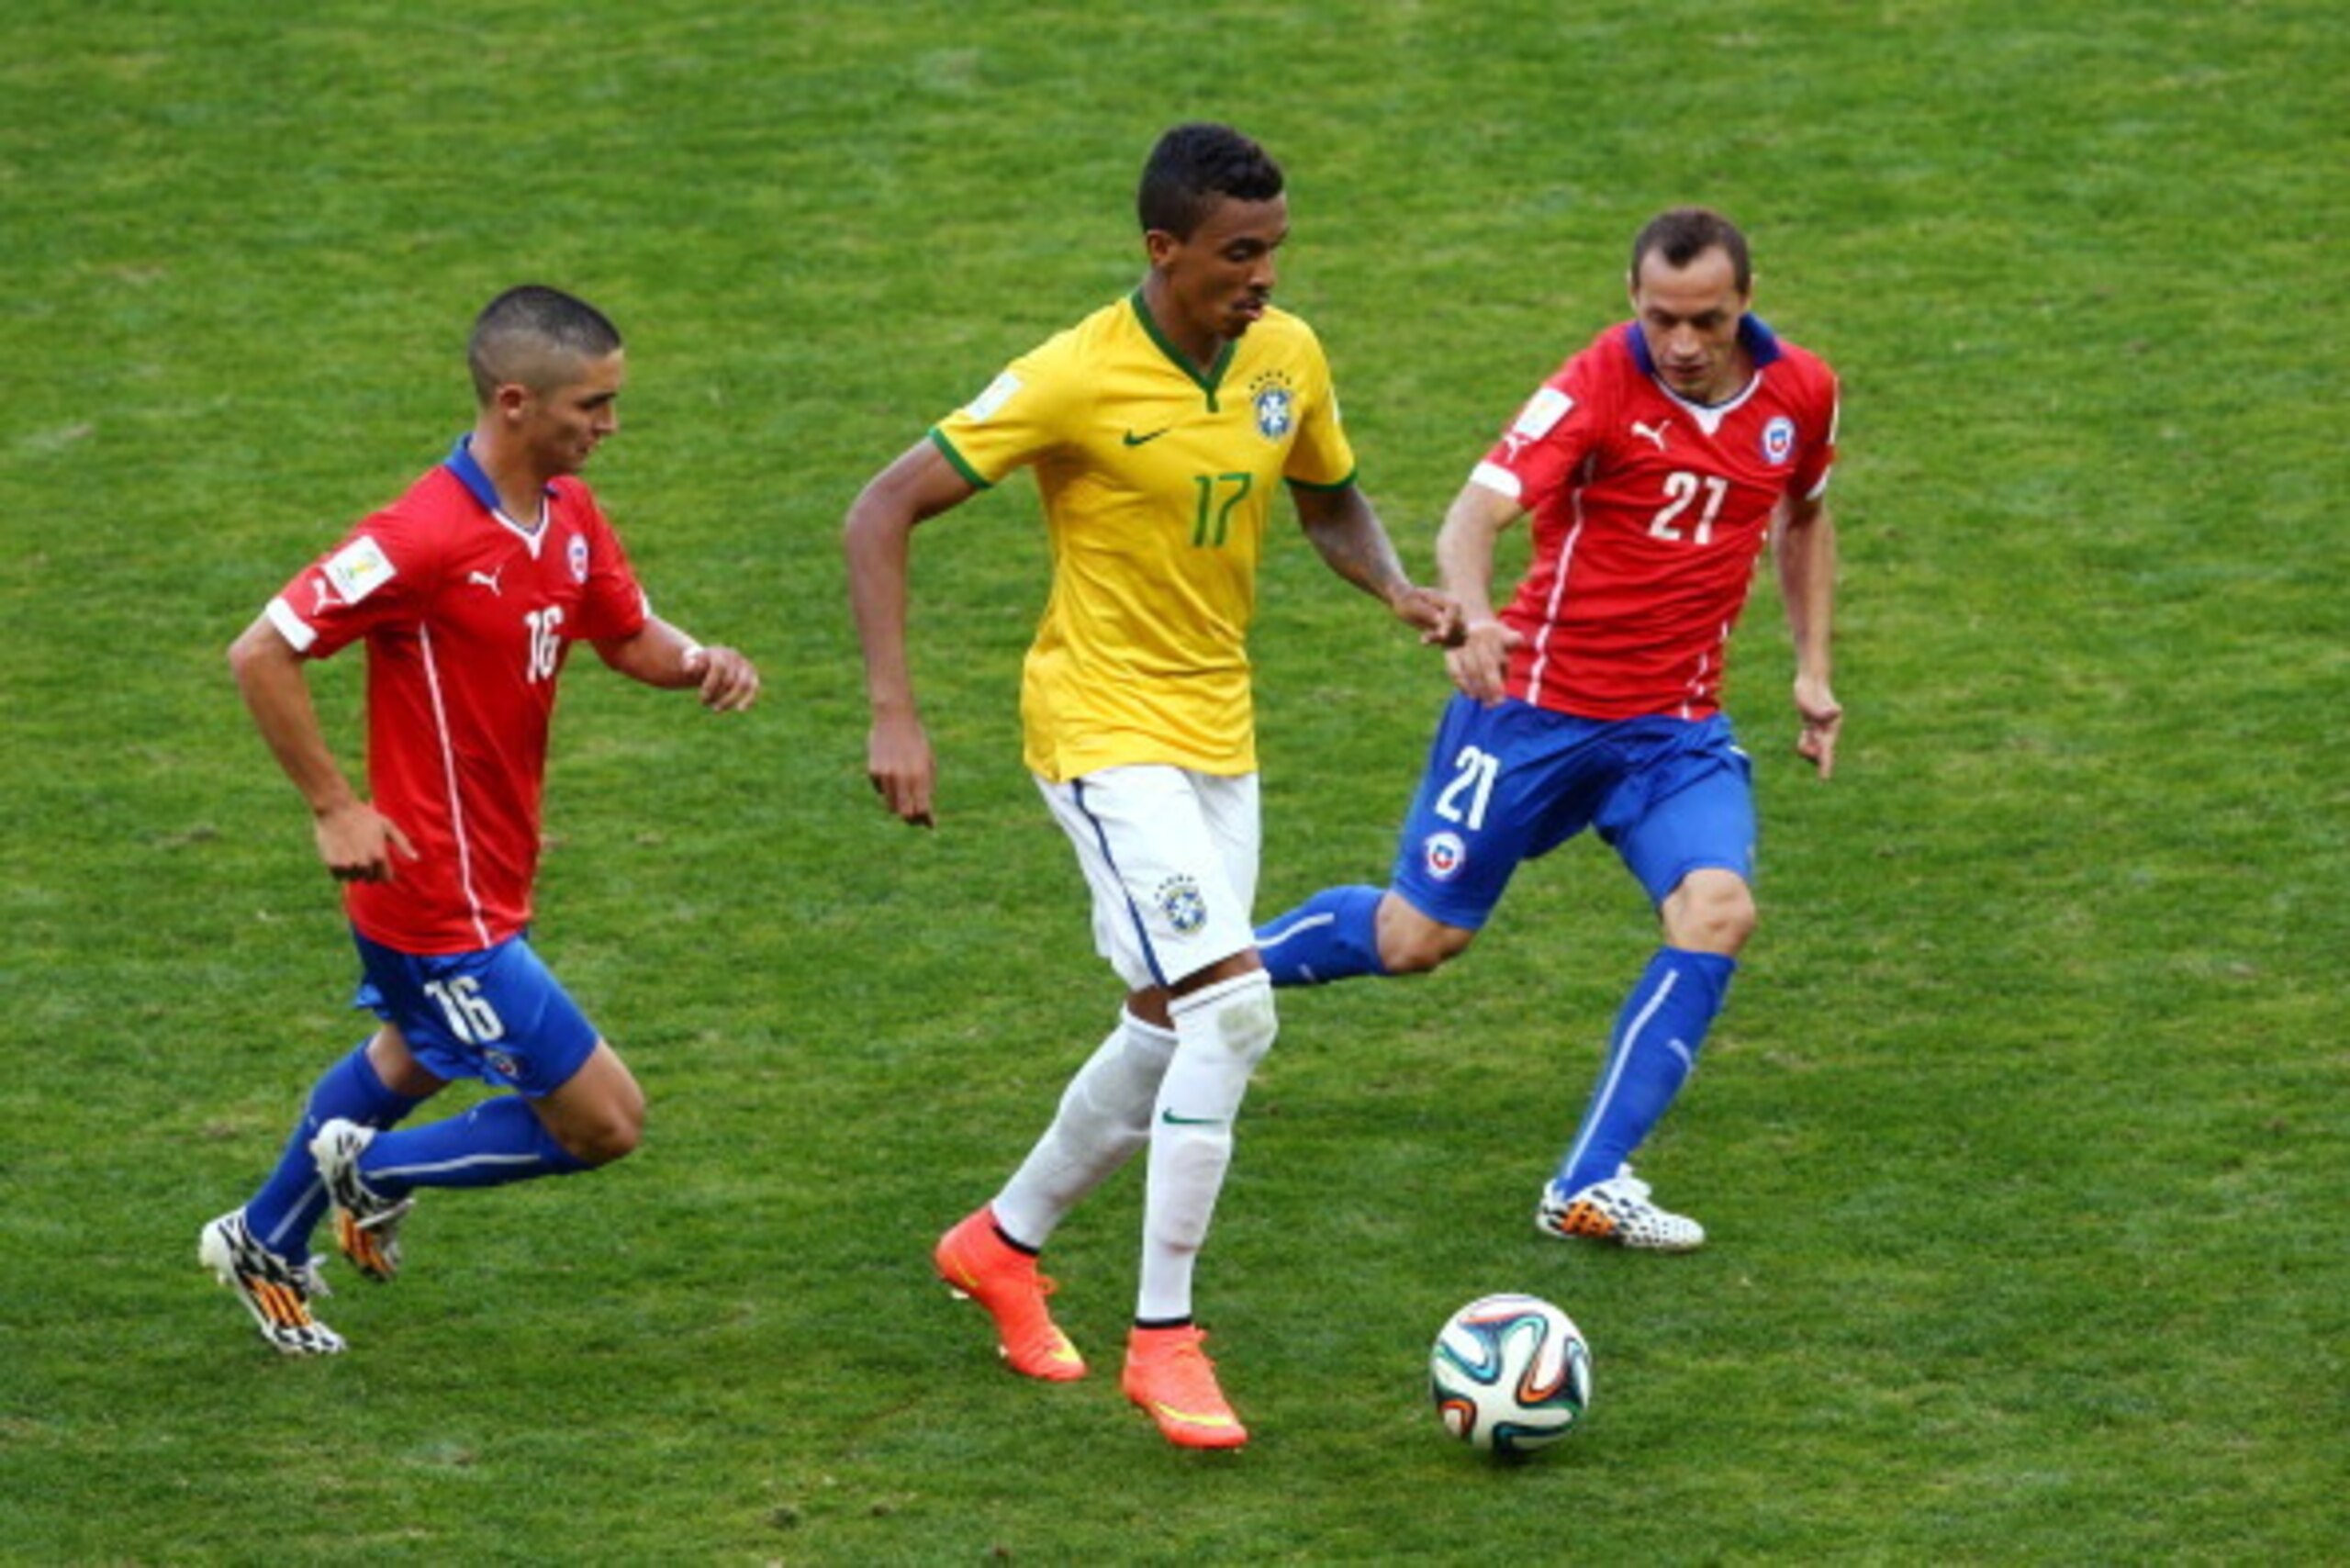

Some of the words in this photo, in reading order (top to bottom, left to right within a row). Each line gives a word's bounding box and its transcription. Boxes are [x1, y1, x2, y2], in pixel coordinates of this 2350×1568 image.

[1192, 473, 1251, 547] 17
[1647, 471, 1729, 545] 21
[524, 605, 563, 683] 16
[1435, 745, 1499, 830] 21
[423, 976, 506, 1046] 16
